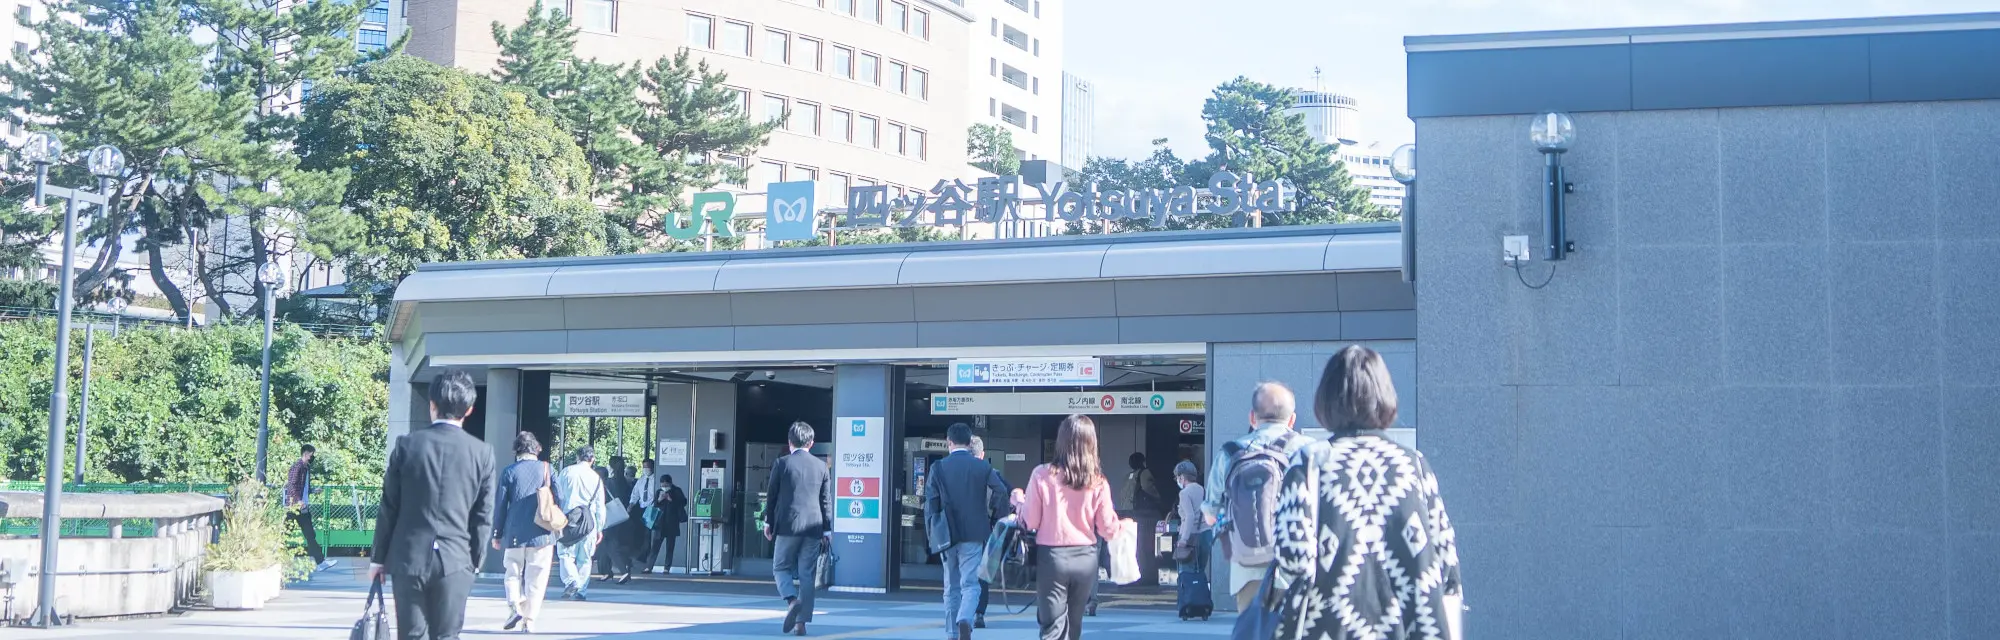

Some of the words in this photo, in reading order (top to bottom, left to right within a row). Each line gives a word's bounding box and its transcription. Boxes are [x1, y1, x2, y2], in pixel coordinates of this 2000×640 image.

[847, 175, 1023, 227] 四ツ谷駅
[1039, 181, 1197, 228] Yotsuya
[1207, 171, 1296, 215] Sta.
[666, 191, 735, 239] JR
[569, 396, 600, 406] 四ツ谷駅
[1068, 397, 1095, 405] 丸ノ内線
[843, 453, 874, 462] 四ツ谷駅
